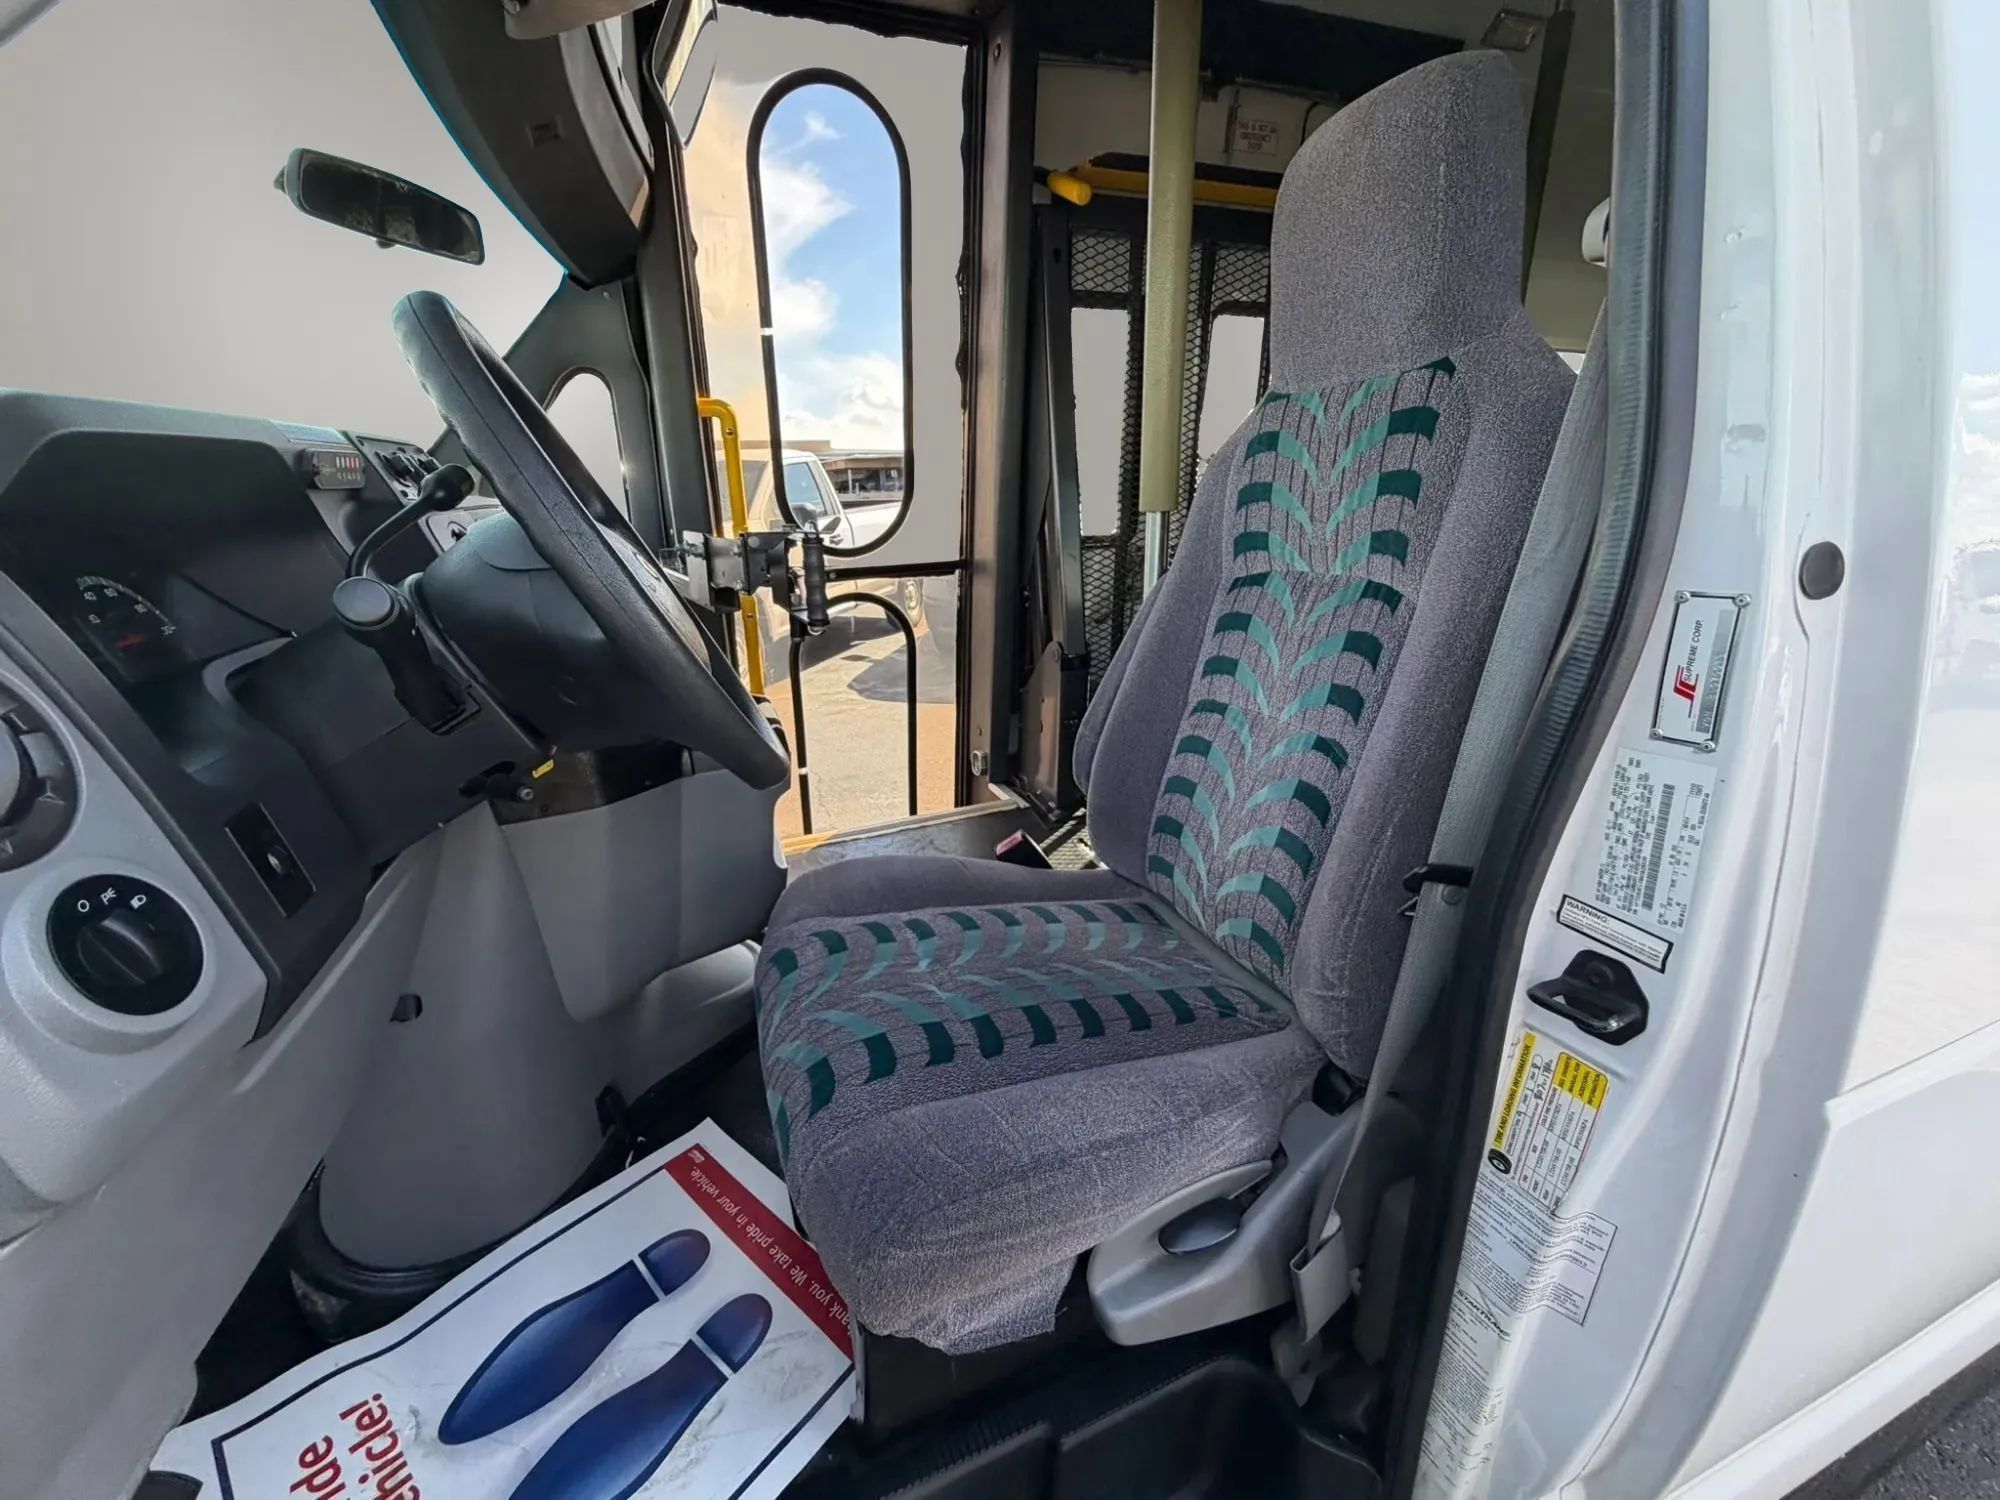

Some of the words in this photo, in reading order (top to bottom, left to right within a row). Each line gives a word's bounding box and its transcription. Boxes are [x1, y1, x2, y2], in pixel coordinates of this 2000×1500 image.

[1682, 644, 1698, 682] SUPREME
[1690, 618, 1703, 643] CORP.
[1566, 899, 1610, 924] WARNING:
[1513, 1045, 1531, 1089] INFORMATION
[1503, 1088, 1516, 1116] LOADING
[1498, 1115, 1508, 1130] AND
[1494, 1128, 1503, 1144] TIRE
[691, 1166, 720, 1198] vehicle.
[716, 1195, 741, 1217] your
[735, 1214, 748, 1228] in
[746, 1224, 774, 1248] pride
[769, 1247, 792, 1269] take
[790, 1265, 808, 1286] We
[810, 1281, 832, 1308] you.
[829, 1301, 852, 1336] hank
